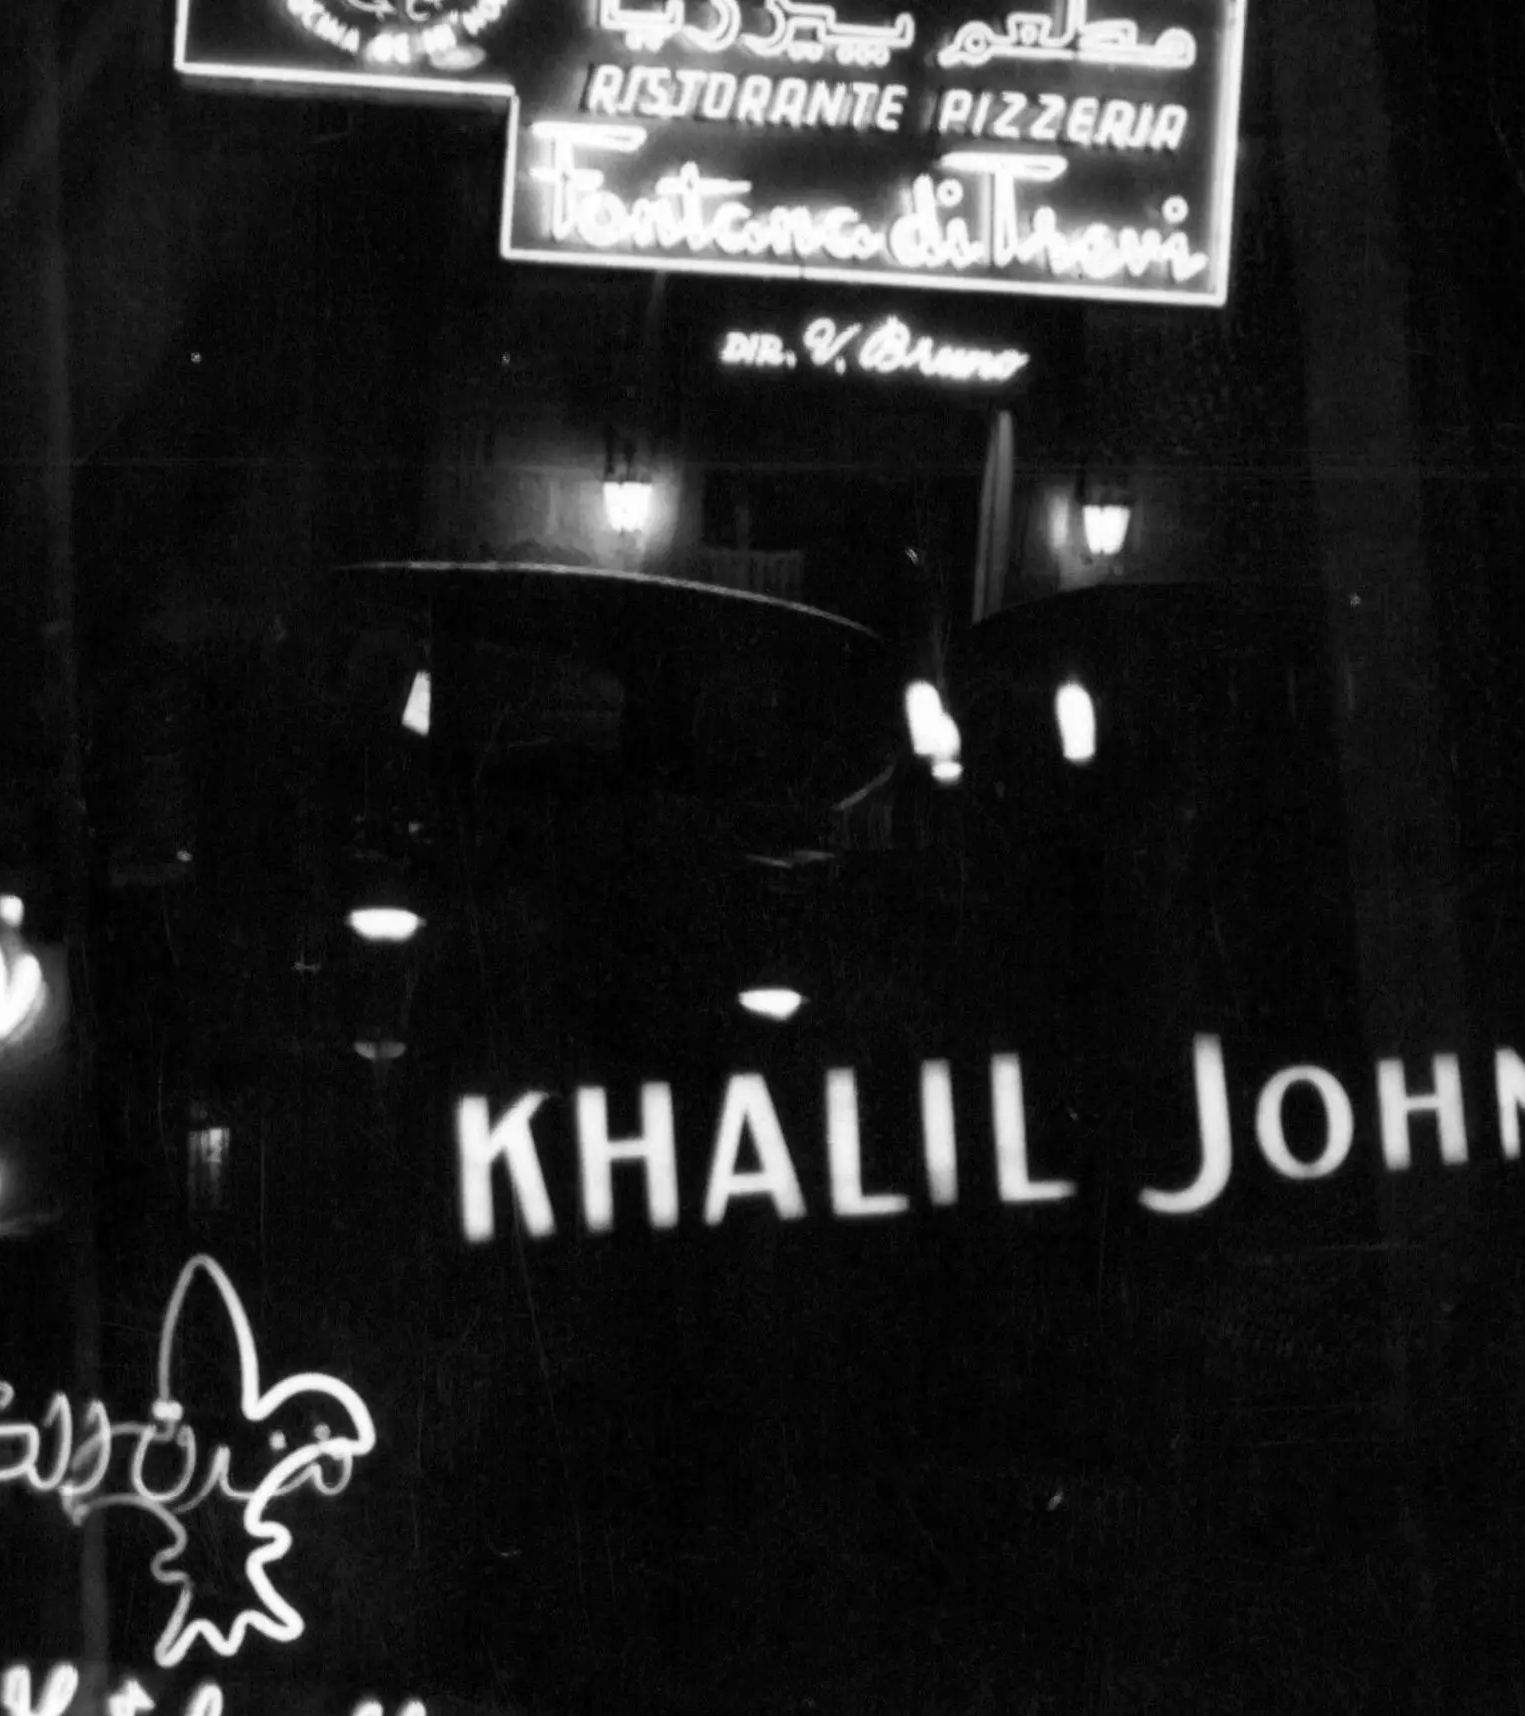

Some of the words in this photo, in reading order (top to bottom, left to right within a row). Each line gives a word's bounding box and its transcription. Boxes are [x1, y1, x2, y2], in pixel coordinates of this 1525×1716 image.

[585, 64, 908, 134] RISTORANTE
[936, 88, 1190, 152] PIZZERIA
[721, 332, 796, 366] DIR.
[456, 1055, 1071, 1241] KHALIL
